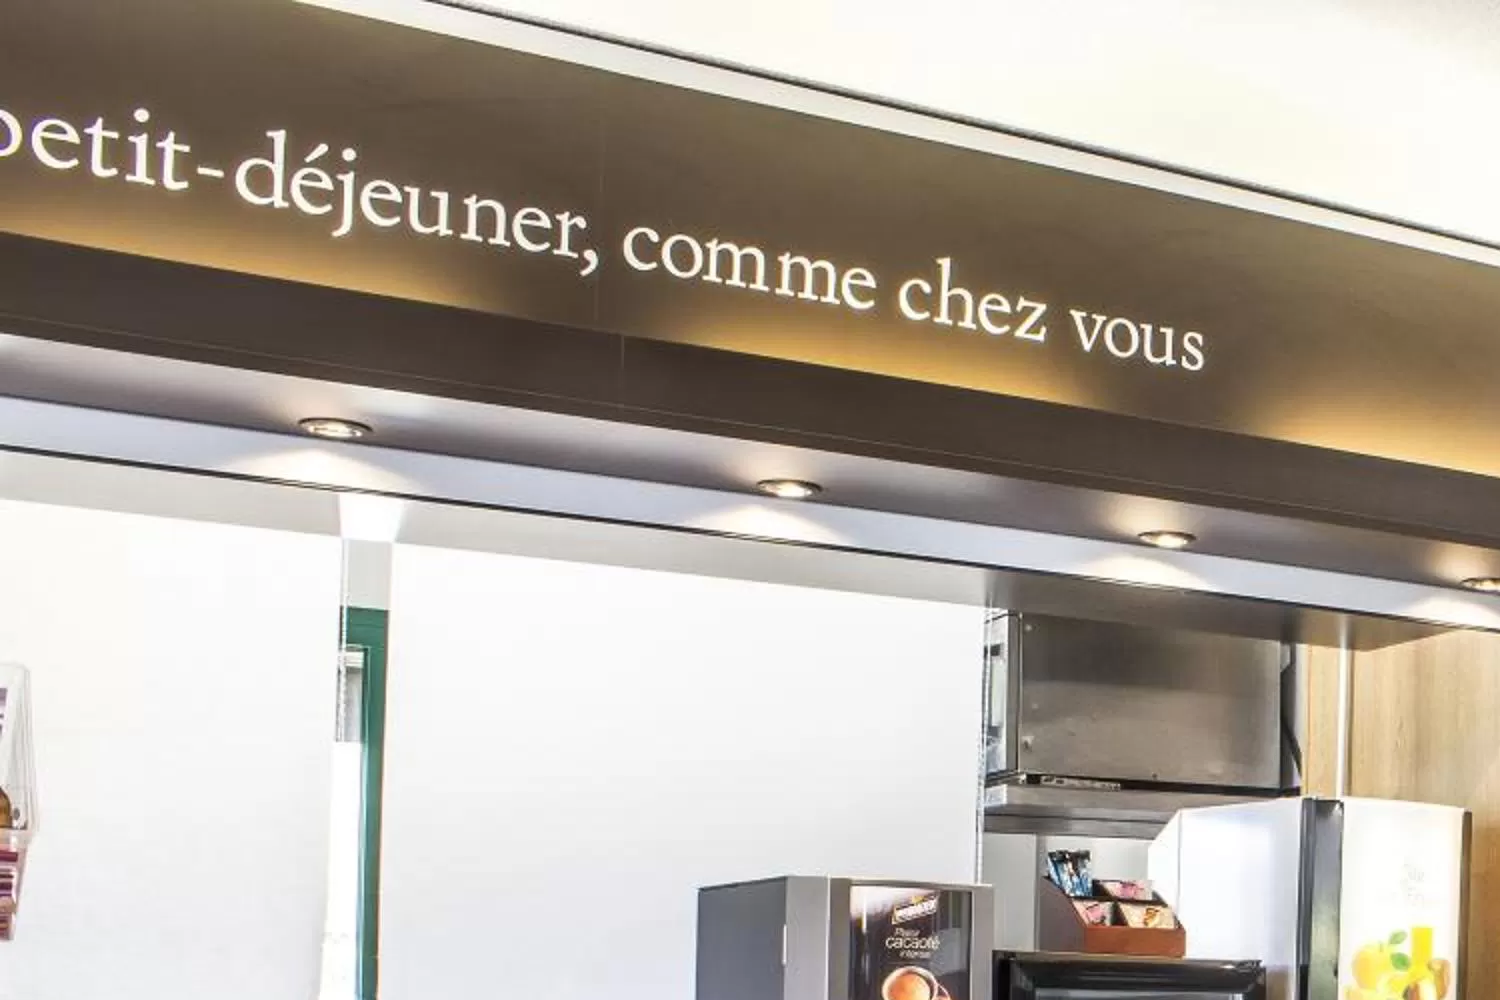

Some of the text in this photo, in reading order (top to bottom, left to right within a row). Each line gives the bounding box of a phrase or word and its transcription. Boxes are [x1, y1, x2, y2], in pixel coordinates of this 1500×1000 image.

[622, 226, 877, 310] comme
[897, 257, 1048, 343] chez
[1071, 308, 1206, 372] vous
